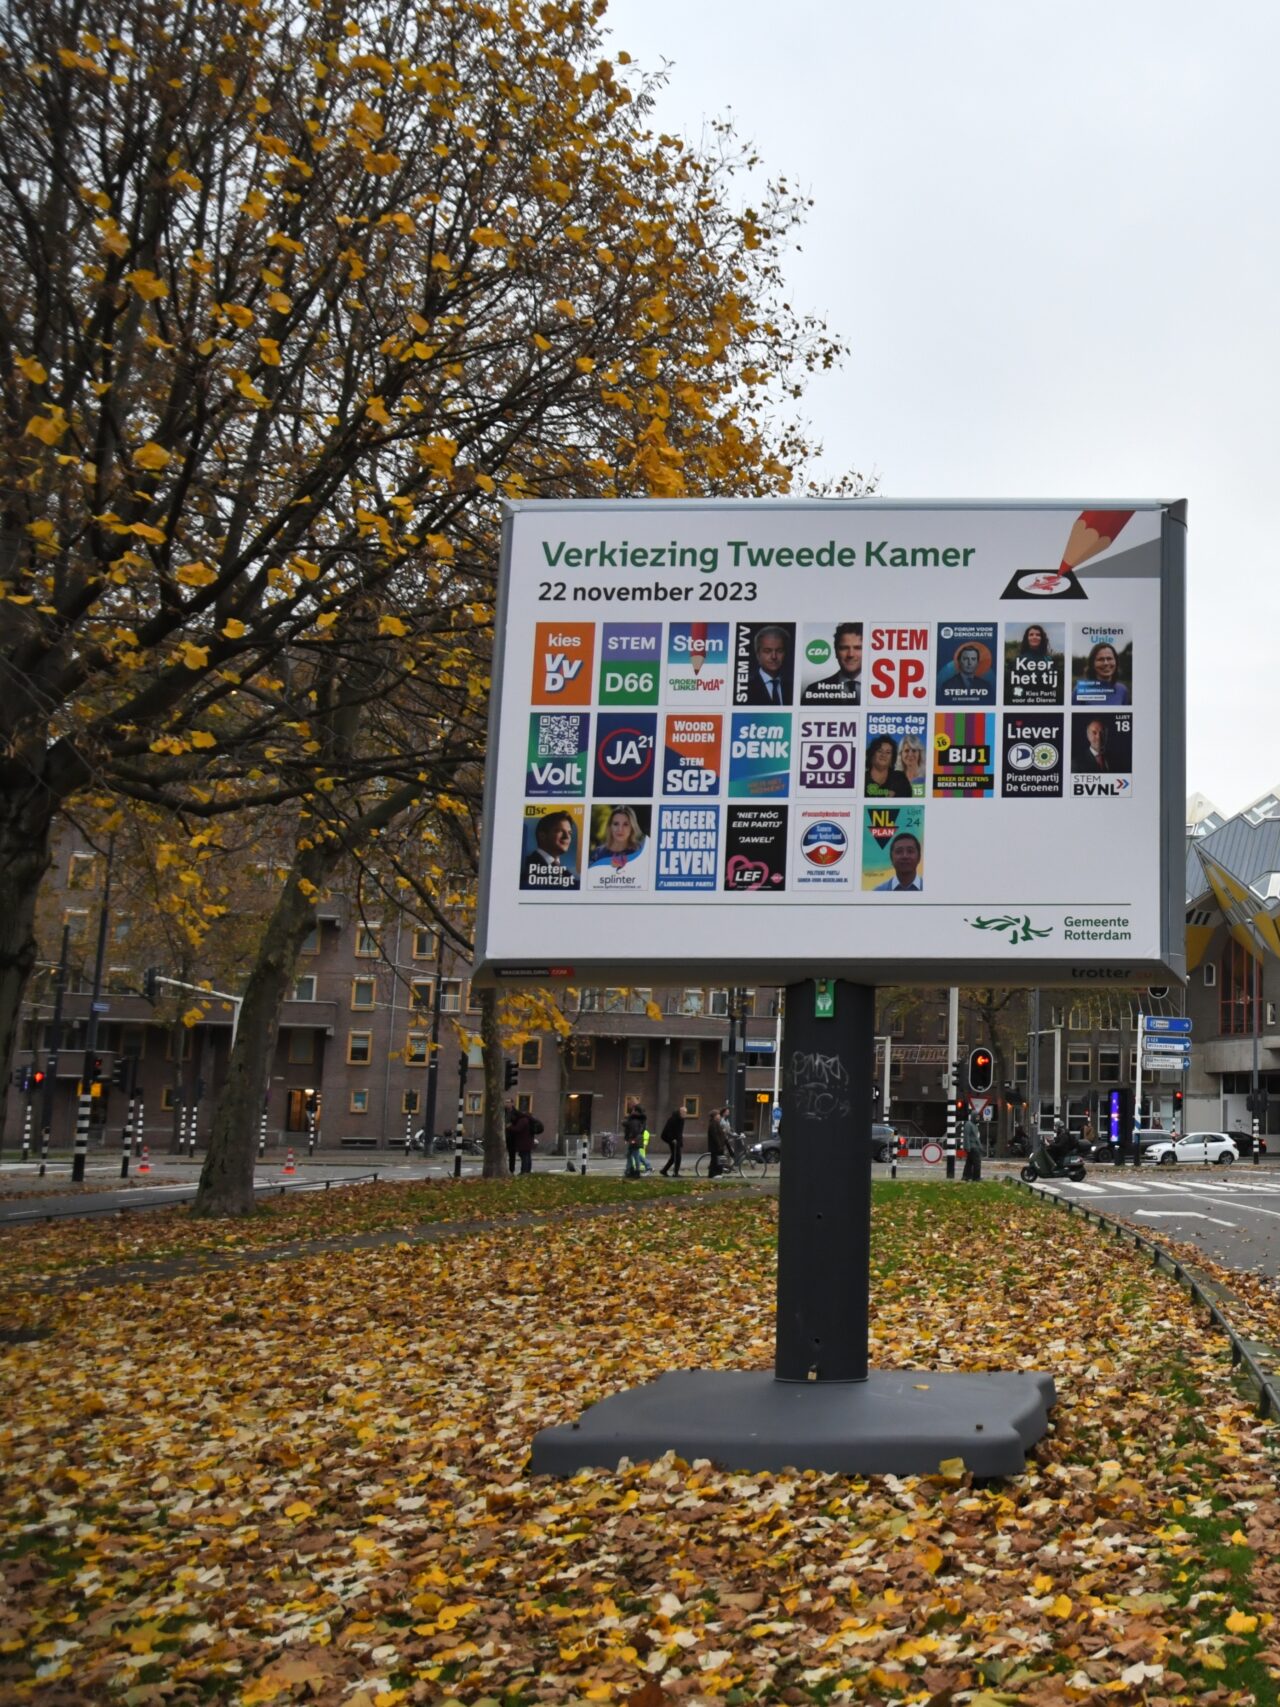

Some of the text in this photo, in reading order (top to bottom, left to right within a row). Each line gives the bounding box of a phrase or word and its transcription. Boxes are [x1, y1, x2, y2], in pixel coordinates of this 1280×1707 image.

[542, 541, 975, 573] Verkiezing Tweede Kamer
[538, 582, 758, 601] 22 november 2023
[1081, 627, 1124, 635] Christen
[548, 633, 581, 647] kies
[607, 636, 656, 650] STEM
[672, 635, 723, 651] Stem
[871, 629, 928, 651] STEM
[807, 648, 829, 656] CDA
[736, 625, 751, 703] STEM PVV
[1015, 657, 1054, 671] Keer
[605, 672, 653, 693] D66
[696, 678, 720, 691] PvdA
[818, 682, 845, 690] Henri
[1010, 671, 1058, 688] het tij
[805, 690, 856, 699] Bontenbal
[869, 714, 925, 725] Iedere dag
[673, 721, 714, 732] WOORD
[739, 723, 784, 739] stem
[801, 722, 857, 738] STEM
[868, 724, 925, 735] BBBeter
[1007, 722, 1059, 739] Liever
[1115, 721, 1131, 732] 18
[672, 733, 715, 743] HOUDEN
[936, 739, 947, 747] 16
[731, 741, 789, 759] DENK
[949, 748, 986, 763] BIJ1
[679, 757, 704, 767] STEM
[805, 744, 848, 770] 50
[531, 762, 582, 786] Volt
[666, 769, 716, 792] SGP
[806, 772, 846, 785] PLUS
[1006, 772, 1059, 783] Piratenpartij
[1073, 775, 1101, 783] STEM
[913, 787, 923, 796] 15
[1006, 783, 1059, 792] De Groenen
[1073, 784, 1119, 796] BVNL
[661, 810, 716, 830] REGEER
[732, 820, 749, 828] EEN
[872, 810, 894, 827] NL
[906, 818, 921, 828] 24
[872, 828, 894, 836] PLAN
[659, 831, 716, 849] JE EIGEN
[529, 863, 567, 874] Pieter
[659, 851, 715, 875] LEVEN
[528, 874, 574, 887] Omtzigt
[599, 875, 637, 887] splinter
[735, 870, 761, 882] LEF
[1064, 916, 1129, 927] Gemeente
[1064, 929, 1131, 940] Rotterdam
